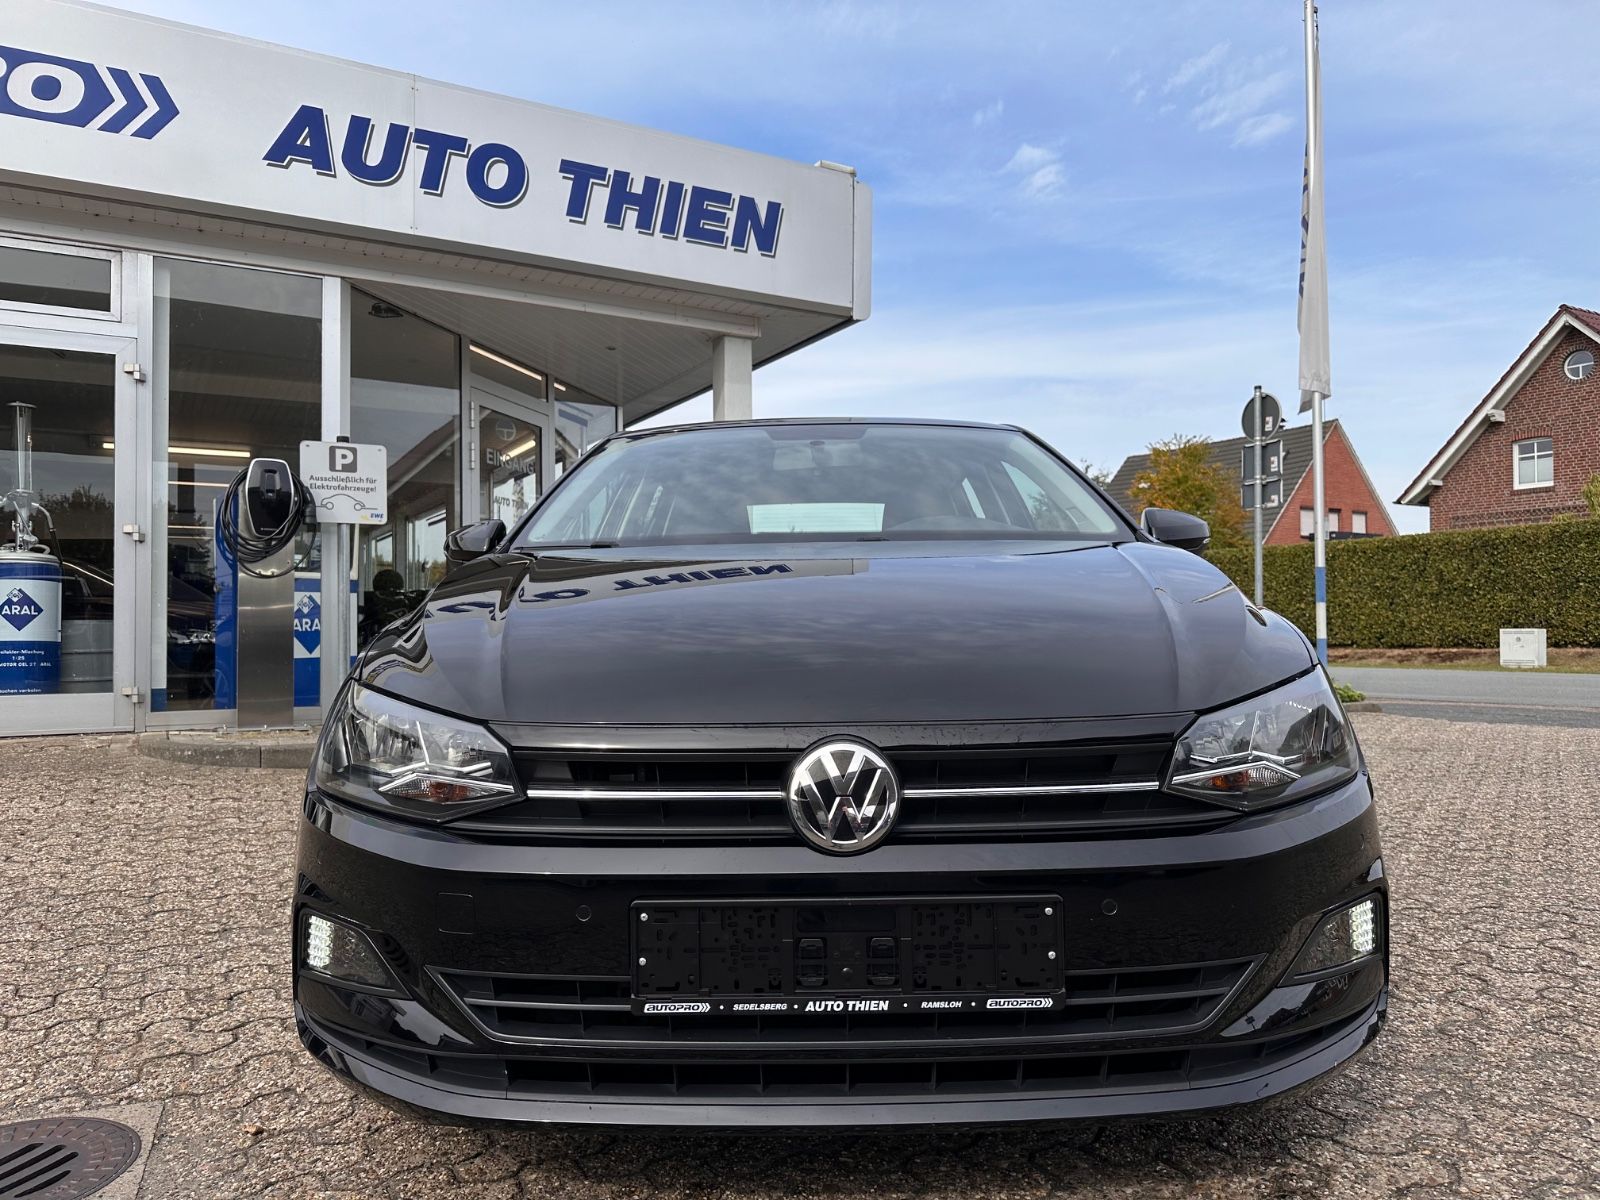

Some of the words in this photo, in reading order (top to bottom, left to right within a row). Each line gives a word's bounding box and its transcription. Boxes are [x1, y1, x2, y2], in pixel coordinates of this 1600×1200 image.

[0, 56, 85, 114] O
[262, 104, 529, 208] AUTO
[558, 158, 783, 258] THIEN
[335, 448, 354, 471] P
[486, 447, 536, 474] EINGANG
[309, 474, 364, 484] Ausschließlich
[1, 605, 39, 615] ARAL
[732, 1003, 788, 1011] SEDELSBERG
[804, 1000, 845, 1012] AUTO
[846, 1000, 890, 1011] THIEN
[920, 1001, 962, 1009] RAMSLOH
